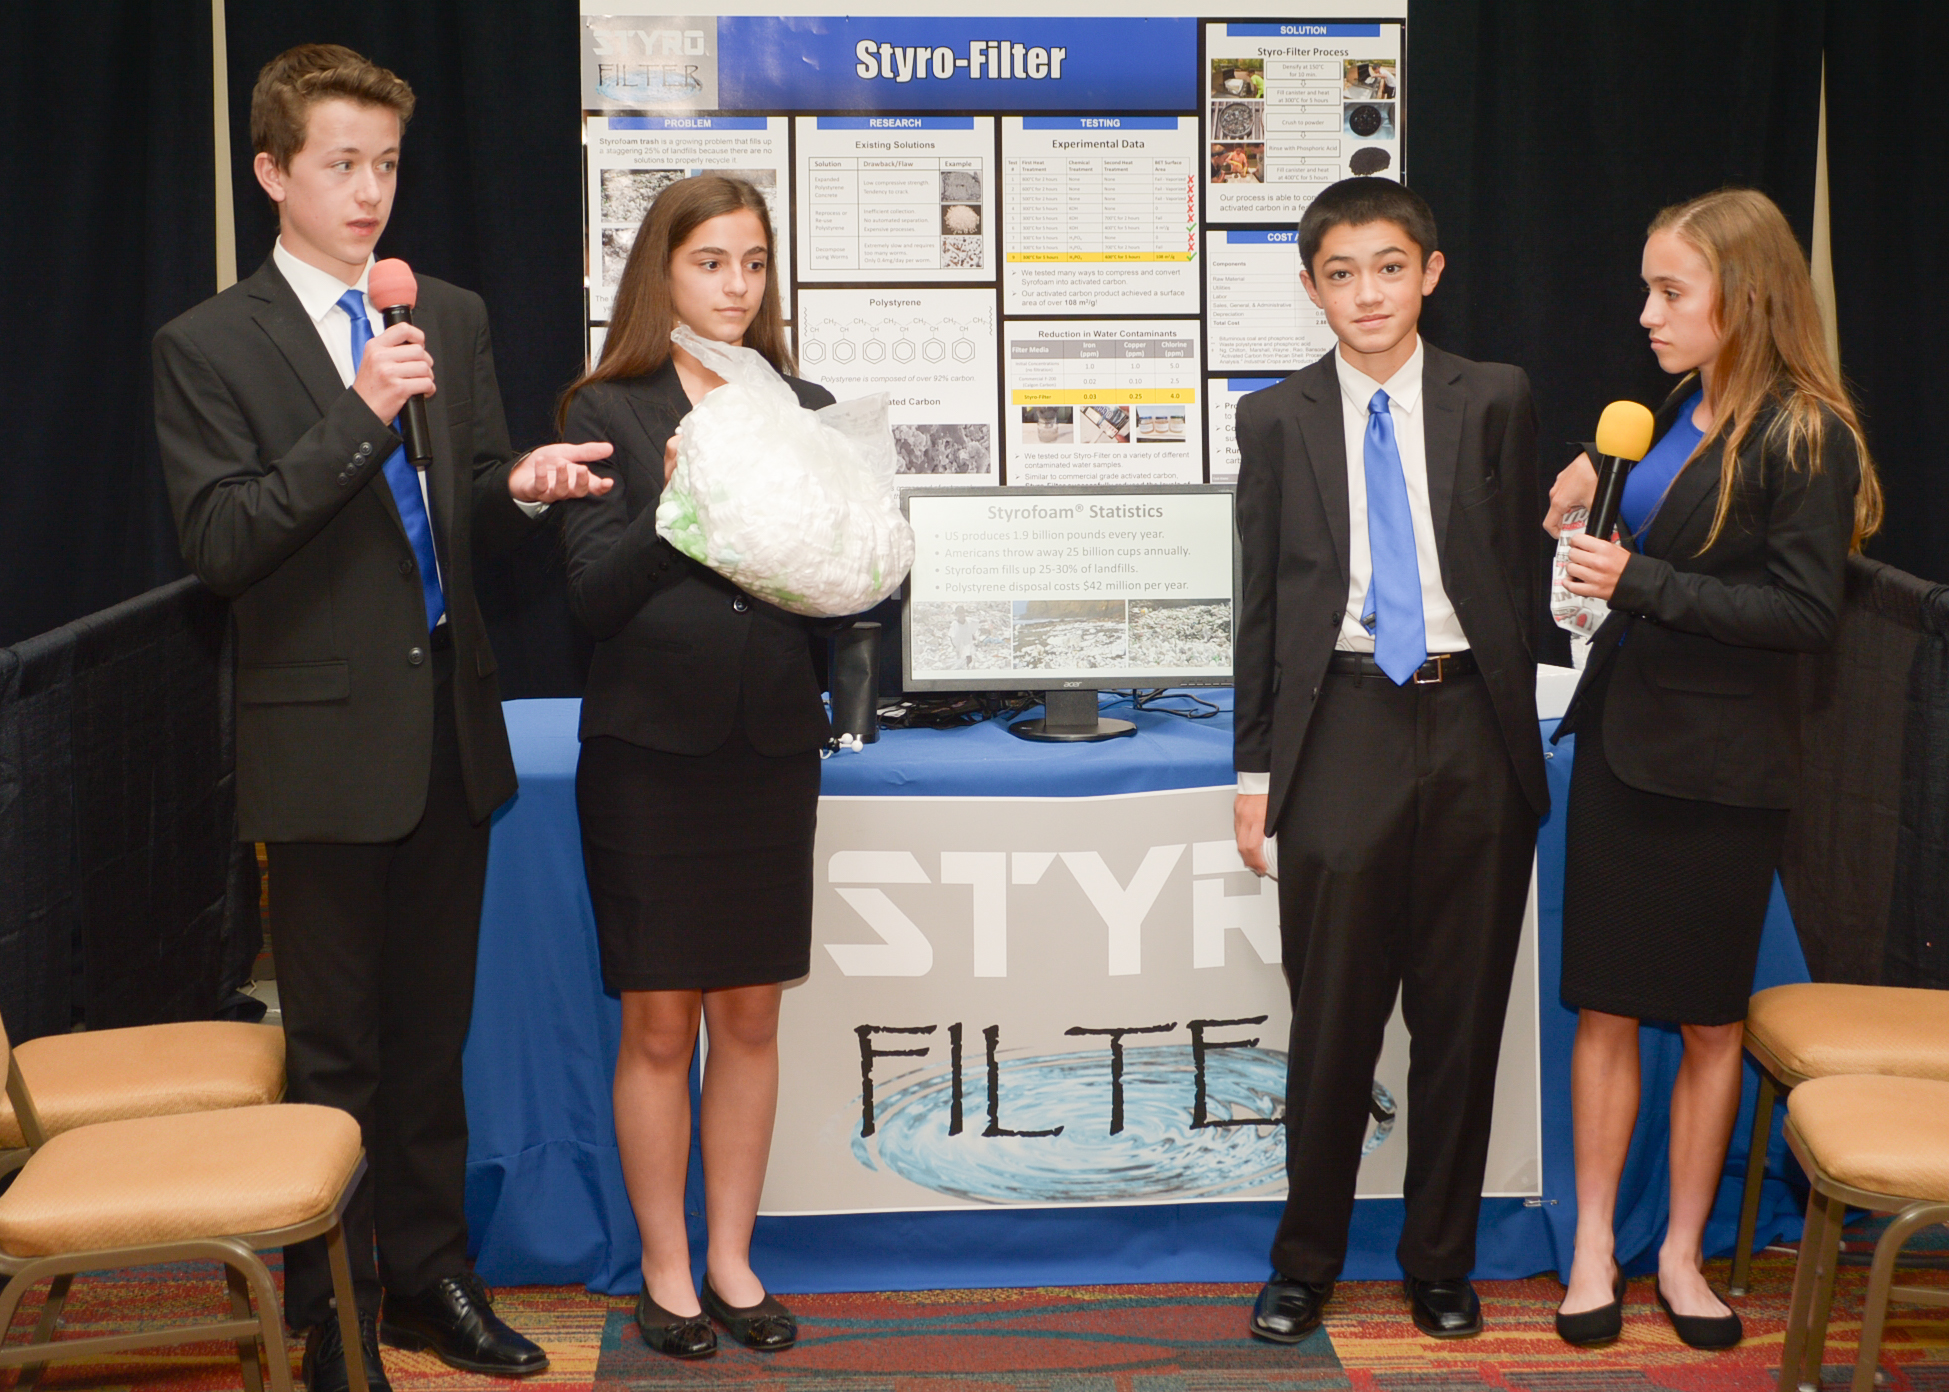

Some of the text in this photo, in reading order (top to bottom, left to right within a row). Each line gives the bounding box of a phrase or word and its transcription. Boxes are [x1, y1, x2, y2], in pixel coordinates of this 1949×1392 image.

[1280, 26, 1327, 34] SOLUTION
[592, 29, 705, 56] STYRO
[1257, 48, 1349, 58] Styro-Filter Process
[855, 39, 1067, 83] Styro-Filter
[597, 63, 702, 89] FILTER
[664, 118, 711, 128] PROBLEM
[870, 118, 922, 128] RESEARCH
[1080, 118, 1120, 127] TESTING
[599, 138, 638, 146] Styrofoam
[675, 138, 703, 146] growing
[704, 138, 733, 146] problem
[855, 141, 892, 150] Existing
[1052, 140, 1145, 150] Experimental Data
[606, 147, 643, 156] staggering
[674, 157, 704, 165] properly
[705, 157, 730, 165] recycle
[1268, 233, 1293, 242] COST
[869, 299, 922, 308] Polystyrene
[1089, 504, 1163, 518] Statistics
[945, 531, 1164, 542] US produces 1.9 billion pounds every year.
[945, 547, 1191, 559] Americans throw away 25 billion cups annually.
[945, 565, 1138, 576] Styrofoam fills up 25-30% of landfills.
[946, 582, 1189, 593] Polystyrene disposal costs $42 million per year.
[824, 839, 1282, 977] STYR
[853, 1015, 1396, 1138] FILTE
